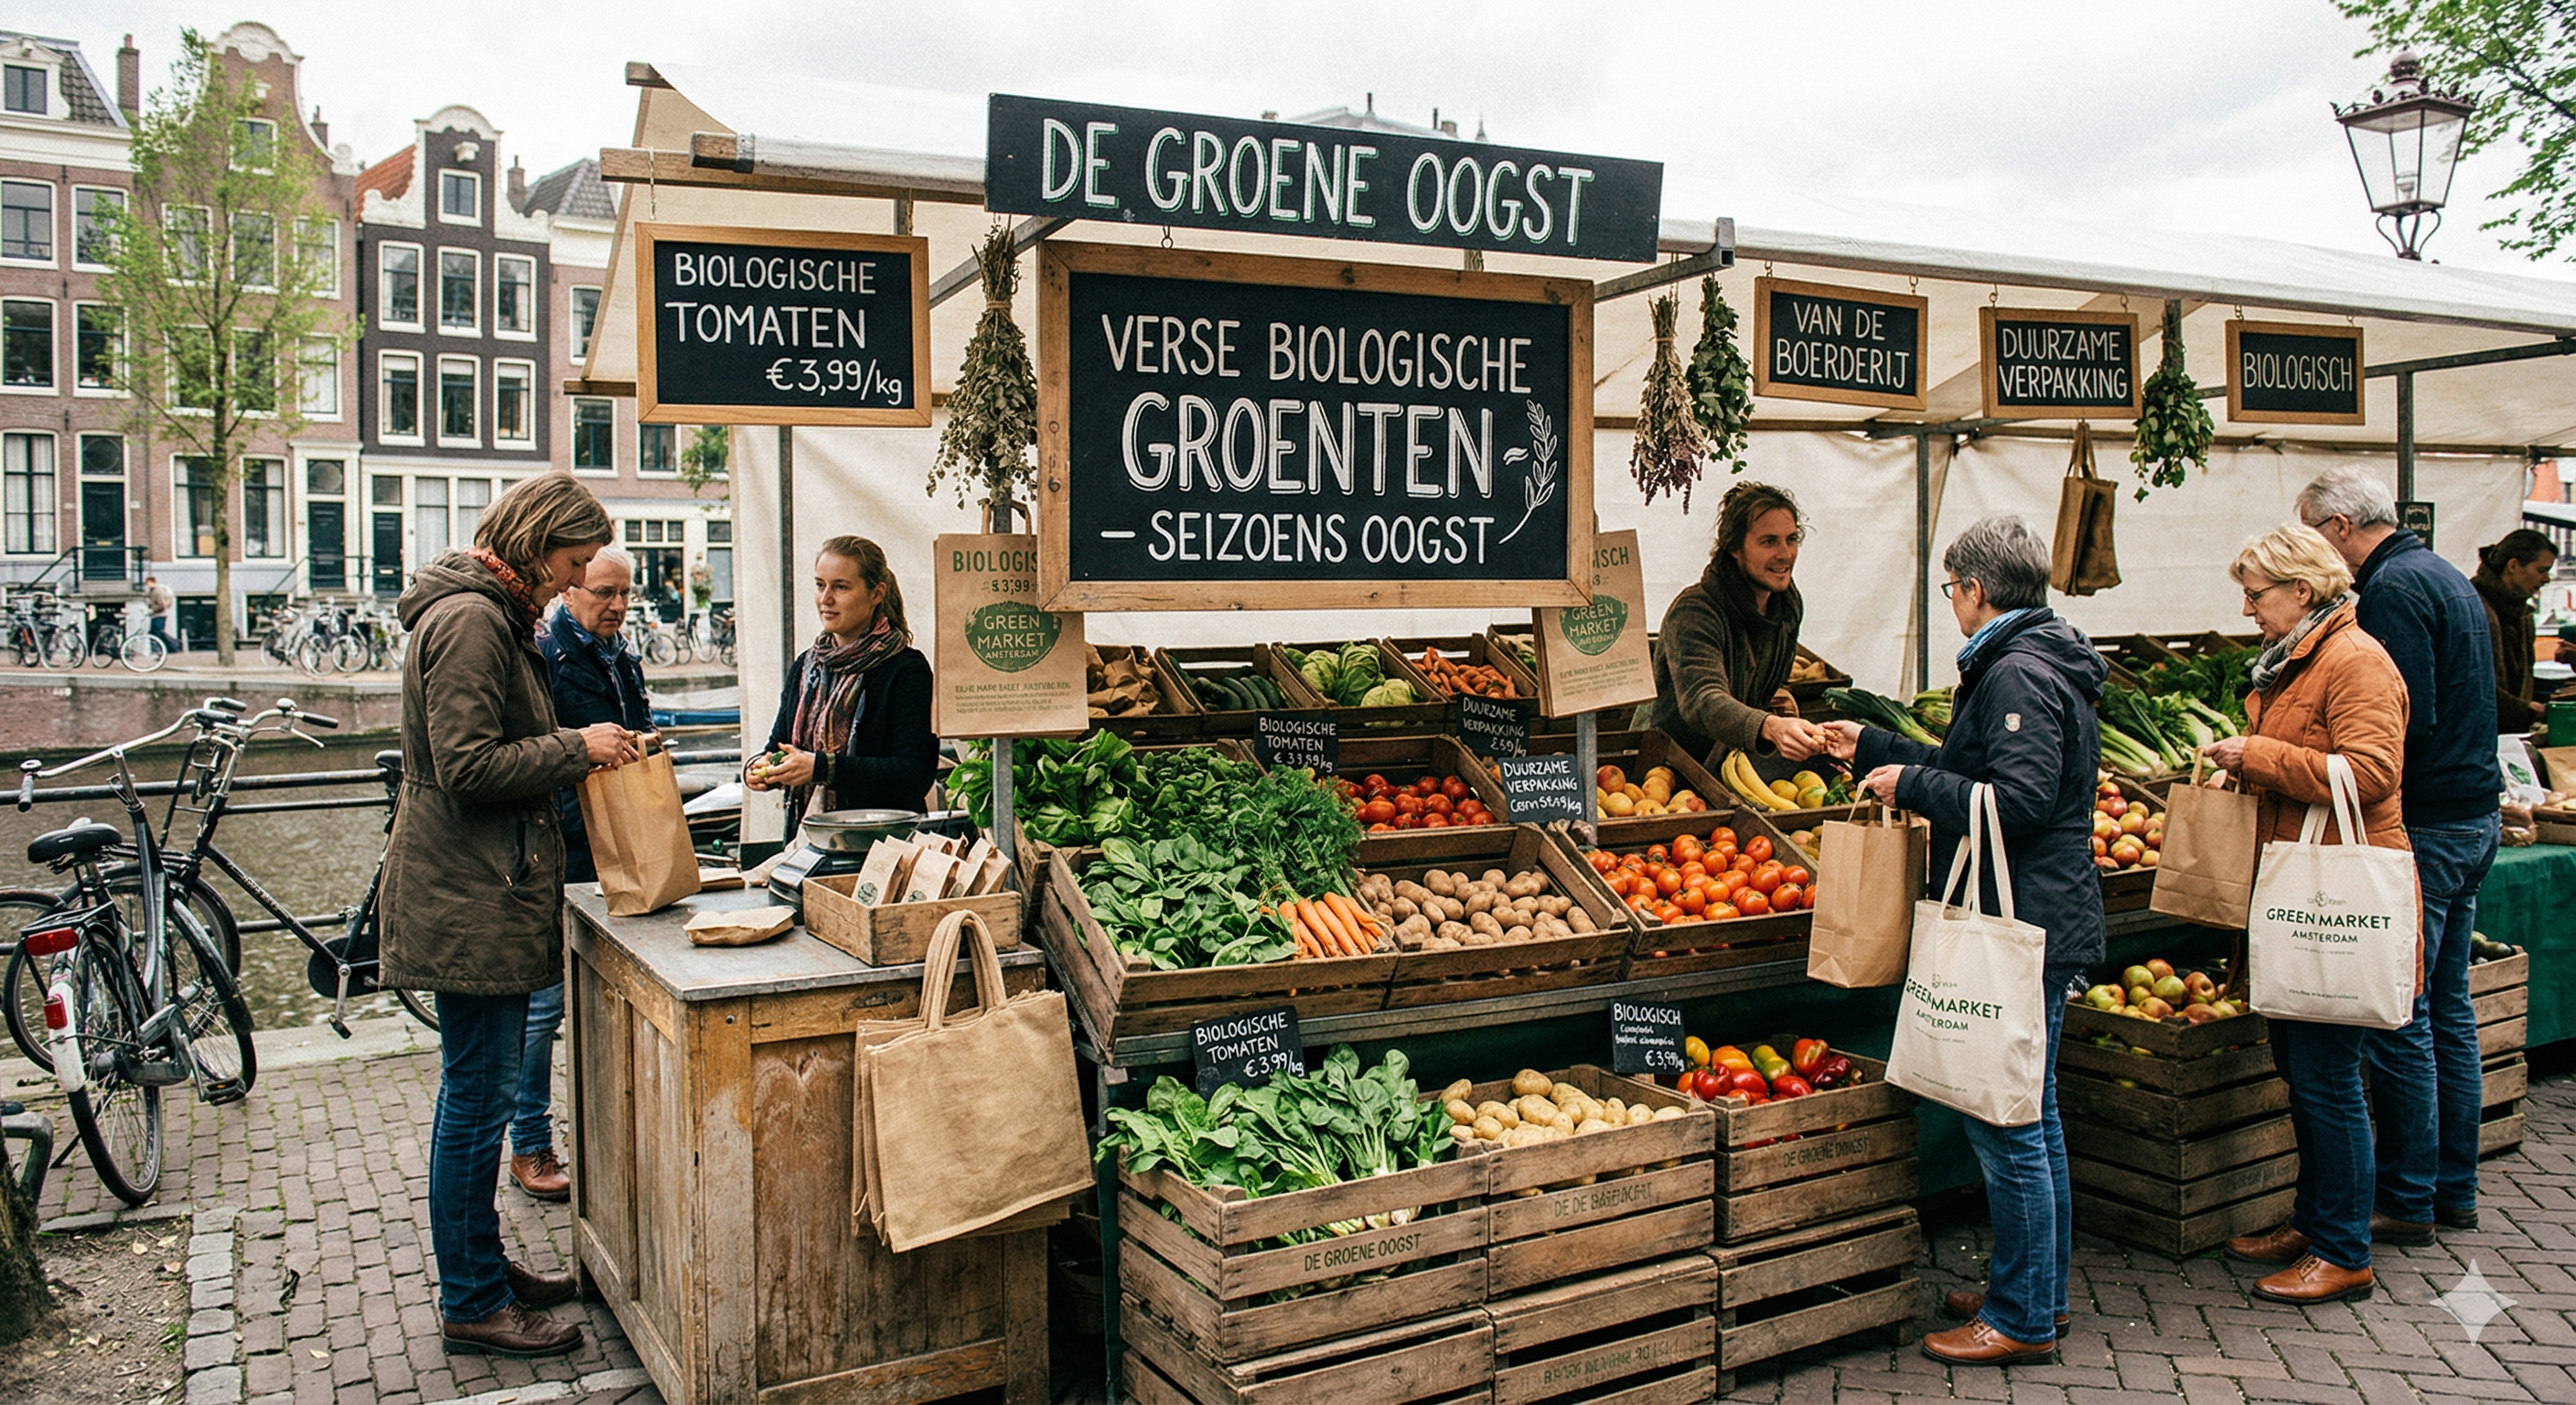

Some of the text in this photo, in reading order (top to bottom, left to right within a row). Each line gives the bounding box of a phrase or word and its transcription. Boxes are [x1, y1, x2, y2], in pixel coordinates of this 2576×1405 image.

[1042, 118, 1595, 245] DE GROENE OOGST
[675, 252, 876, 294] BIOLOGISCHE
[665, 301, 865, 349] TOMATEN
[1793, 301, 1885, 340] VAN DE
[1100, 313, 1532, 393] VERSE BIOLOGISCHE
[2002, 327, 2121, 361] DUURZAME
[1776, 338, 1910, 389] BOERDERIJ
[2243, 351, 2353, 391] BIOLOGISCH
[766, 358, 902, 405] €3,99/kg
[1998, 364, 2128, 400] VERPAKKING
[1122, 391, 1493, 499] GROENTEN
[1147, 509, 1495, 564] SEIZOENS OOGST
[1593, 546, 1629, 569] ISCH
[983, 615, 1040, 630] GREEN
[1569, 617, 1617, 638] MARKET
[1572, 603, 1614, 621] GREEN
[977, 632, 1046, 650] MARKET
[1259, 717, 1336, 735] BIOLOGISCHE
[1265, 735, 1323, 751] TOMATEN
[1503, 760, 1571, 778] DUURZAME
[1507, 777, 1577, 794] VERPAKKING
[2266, 908, 2391, 929] GREEN MARKET
[2292, 929, 2358, 943] AMSTERDAM
[1614, 1003, 1681, 1025] BIOLOGISCH
[1931, 997, 2002, 1020] MARKET
[1196, 1012, 1288, 1046] BIOLOGISCHE
[1207, 1034, 1279, 1064] TOMATEN
[1304, 1233, 1421, 1271] DE GROENE OOGST
